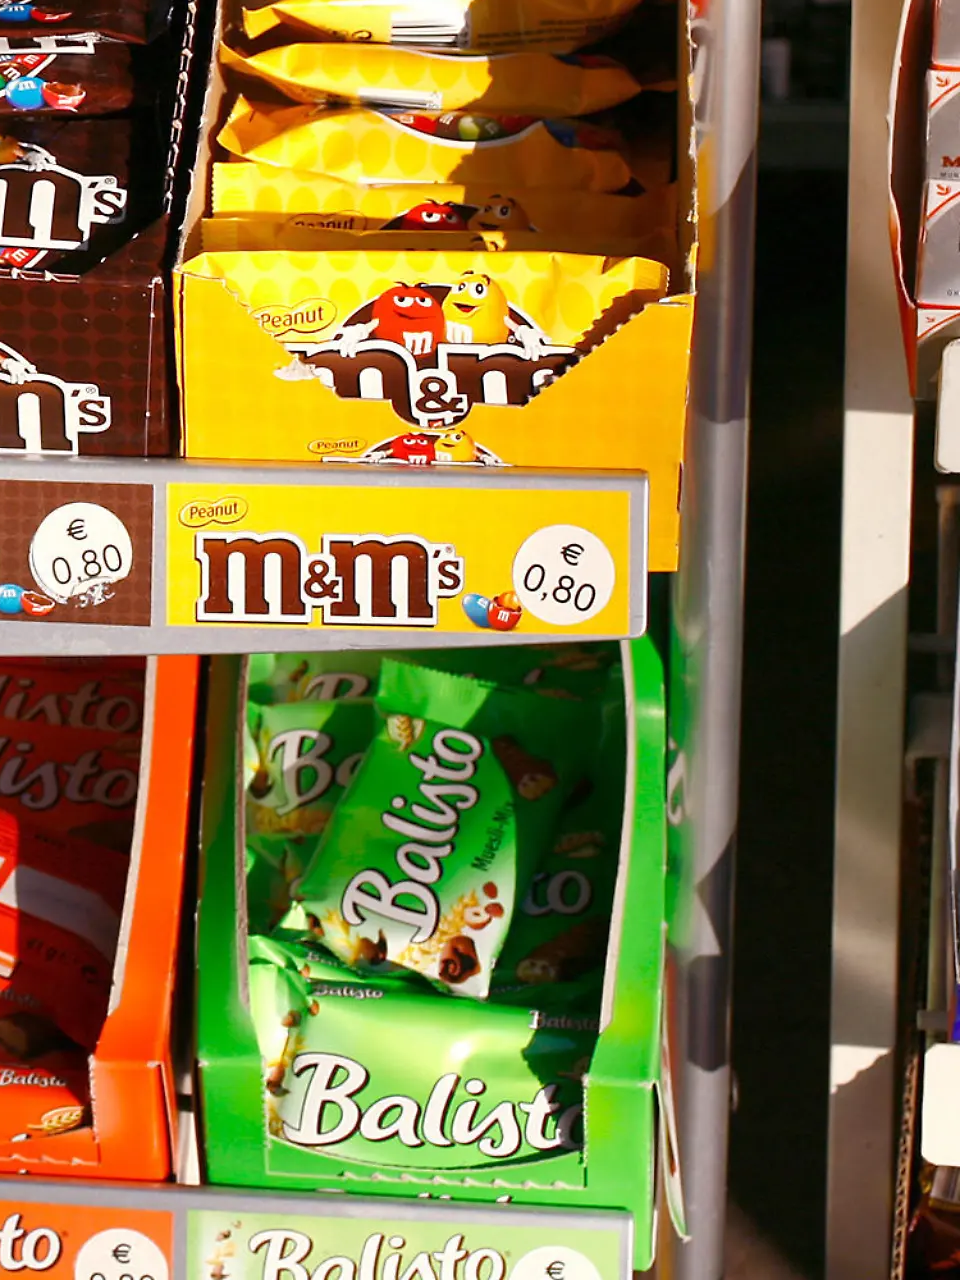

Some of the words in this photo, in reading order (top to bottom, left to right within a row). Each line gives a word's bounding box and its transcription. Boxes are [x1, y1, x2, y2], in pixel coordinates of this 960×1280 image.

[259, 305, 325, 329] Peanut
[316, 438, 360, 452] Peanut
[189, 502, 239, 521] Peanut
[67, 518, 88, 541] €
[51, 544, 123, 586] 0,80
[561, 543, 585, 566] €
[523, 564, 597, 612] 0,80
[340, 729, 487, 945] Balisto
[111, 1243, 132, 1264] €
